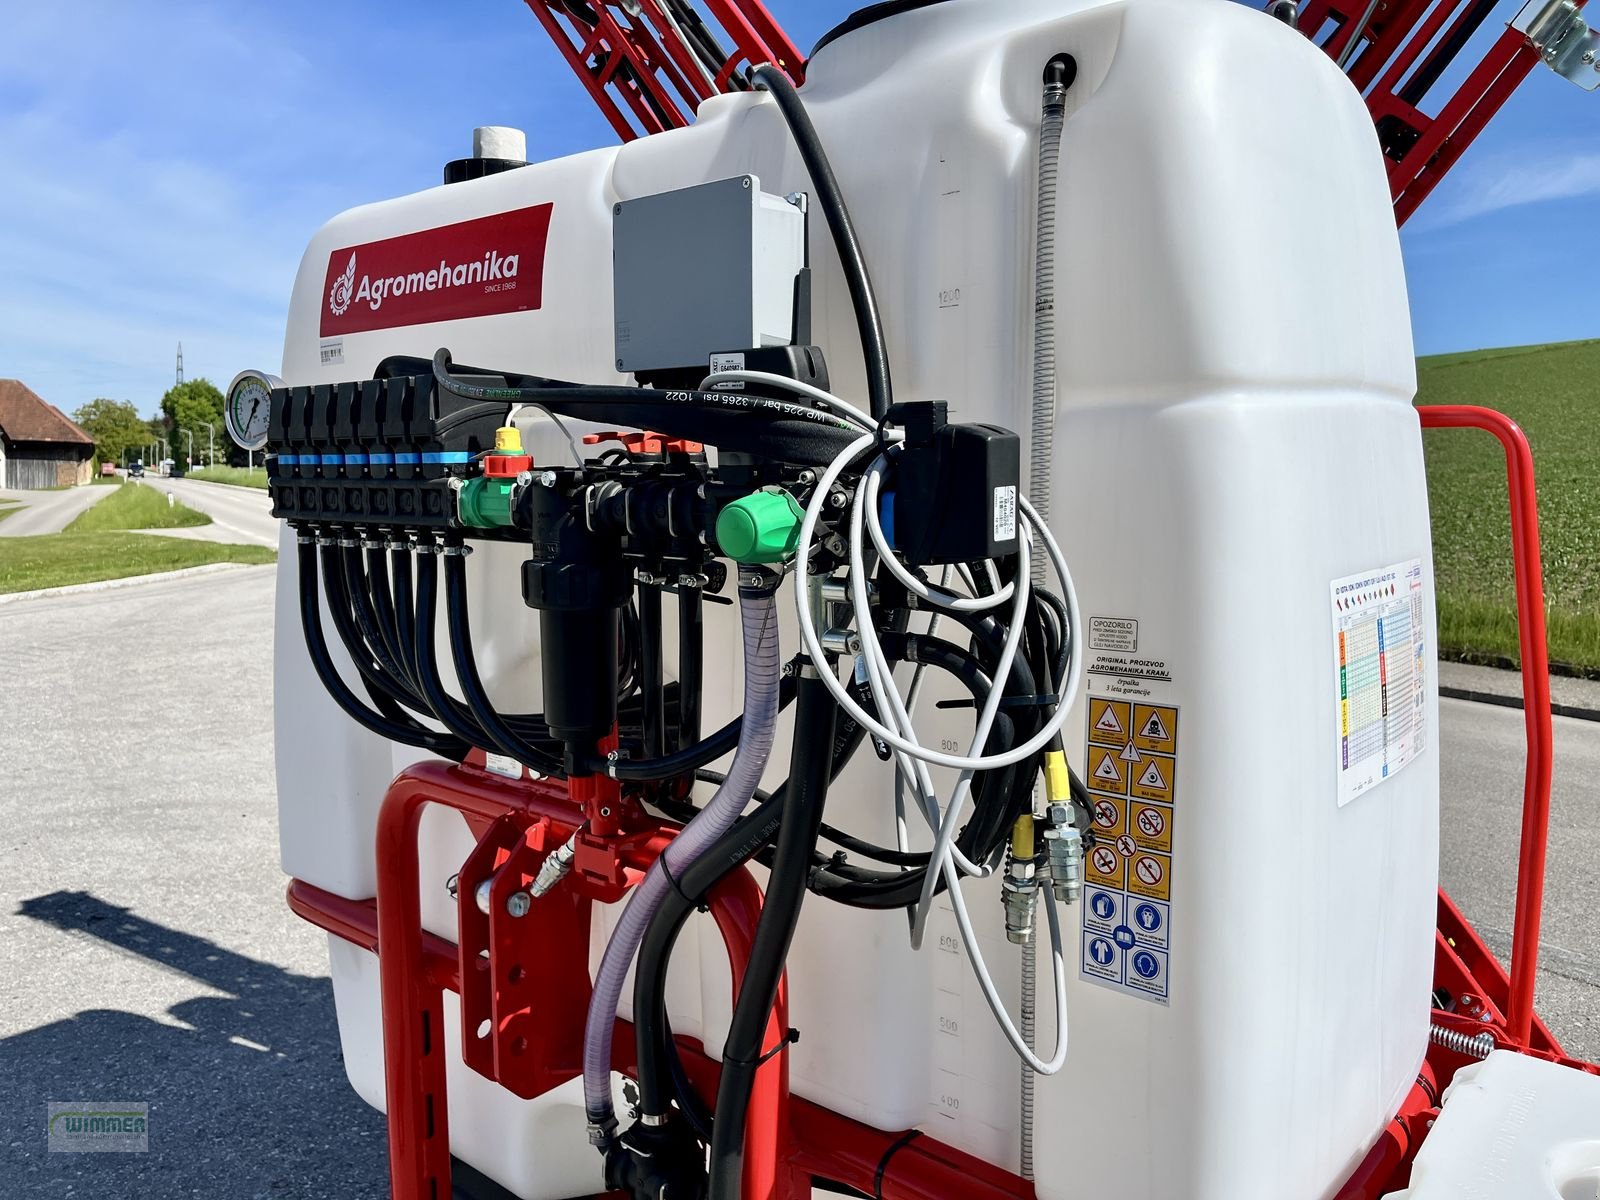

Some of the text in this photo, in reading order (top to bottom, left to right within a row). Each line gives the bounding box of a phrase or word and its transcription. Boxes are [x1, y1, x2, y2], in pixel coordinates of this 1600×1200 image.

[355, 250, 519, 311] Agromehanika
[484, 281, 517, 293] SINCE 1968
[486, 389, 522, 399] GREENLINE
[665, 391, 693, 401] 1Q22
[703, 393, 719, 401] psi
[722, 395, 749, 406] 3265
[763, 400, 780, 411] bar
[784, 405, 803, 416] 225
[806, 411, 825, 422] WP
[1093, 620, 1132, 630] OPOZORILO
[1096, 656, 1165, 668] ORIGINAL PROIZVOD
[1090, 664, 1170, 677] AGROMEHANIKA KRANJ
[1122, 687, 1151, 696] garancije
[941, 739, 959, 752] 800
[939, 1016, 958, 1032] 500
[940, 1095, 959, 1110] 400
